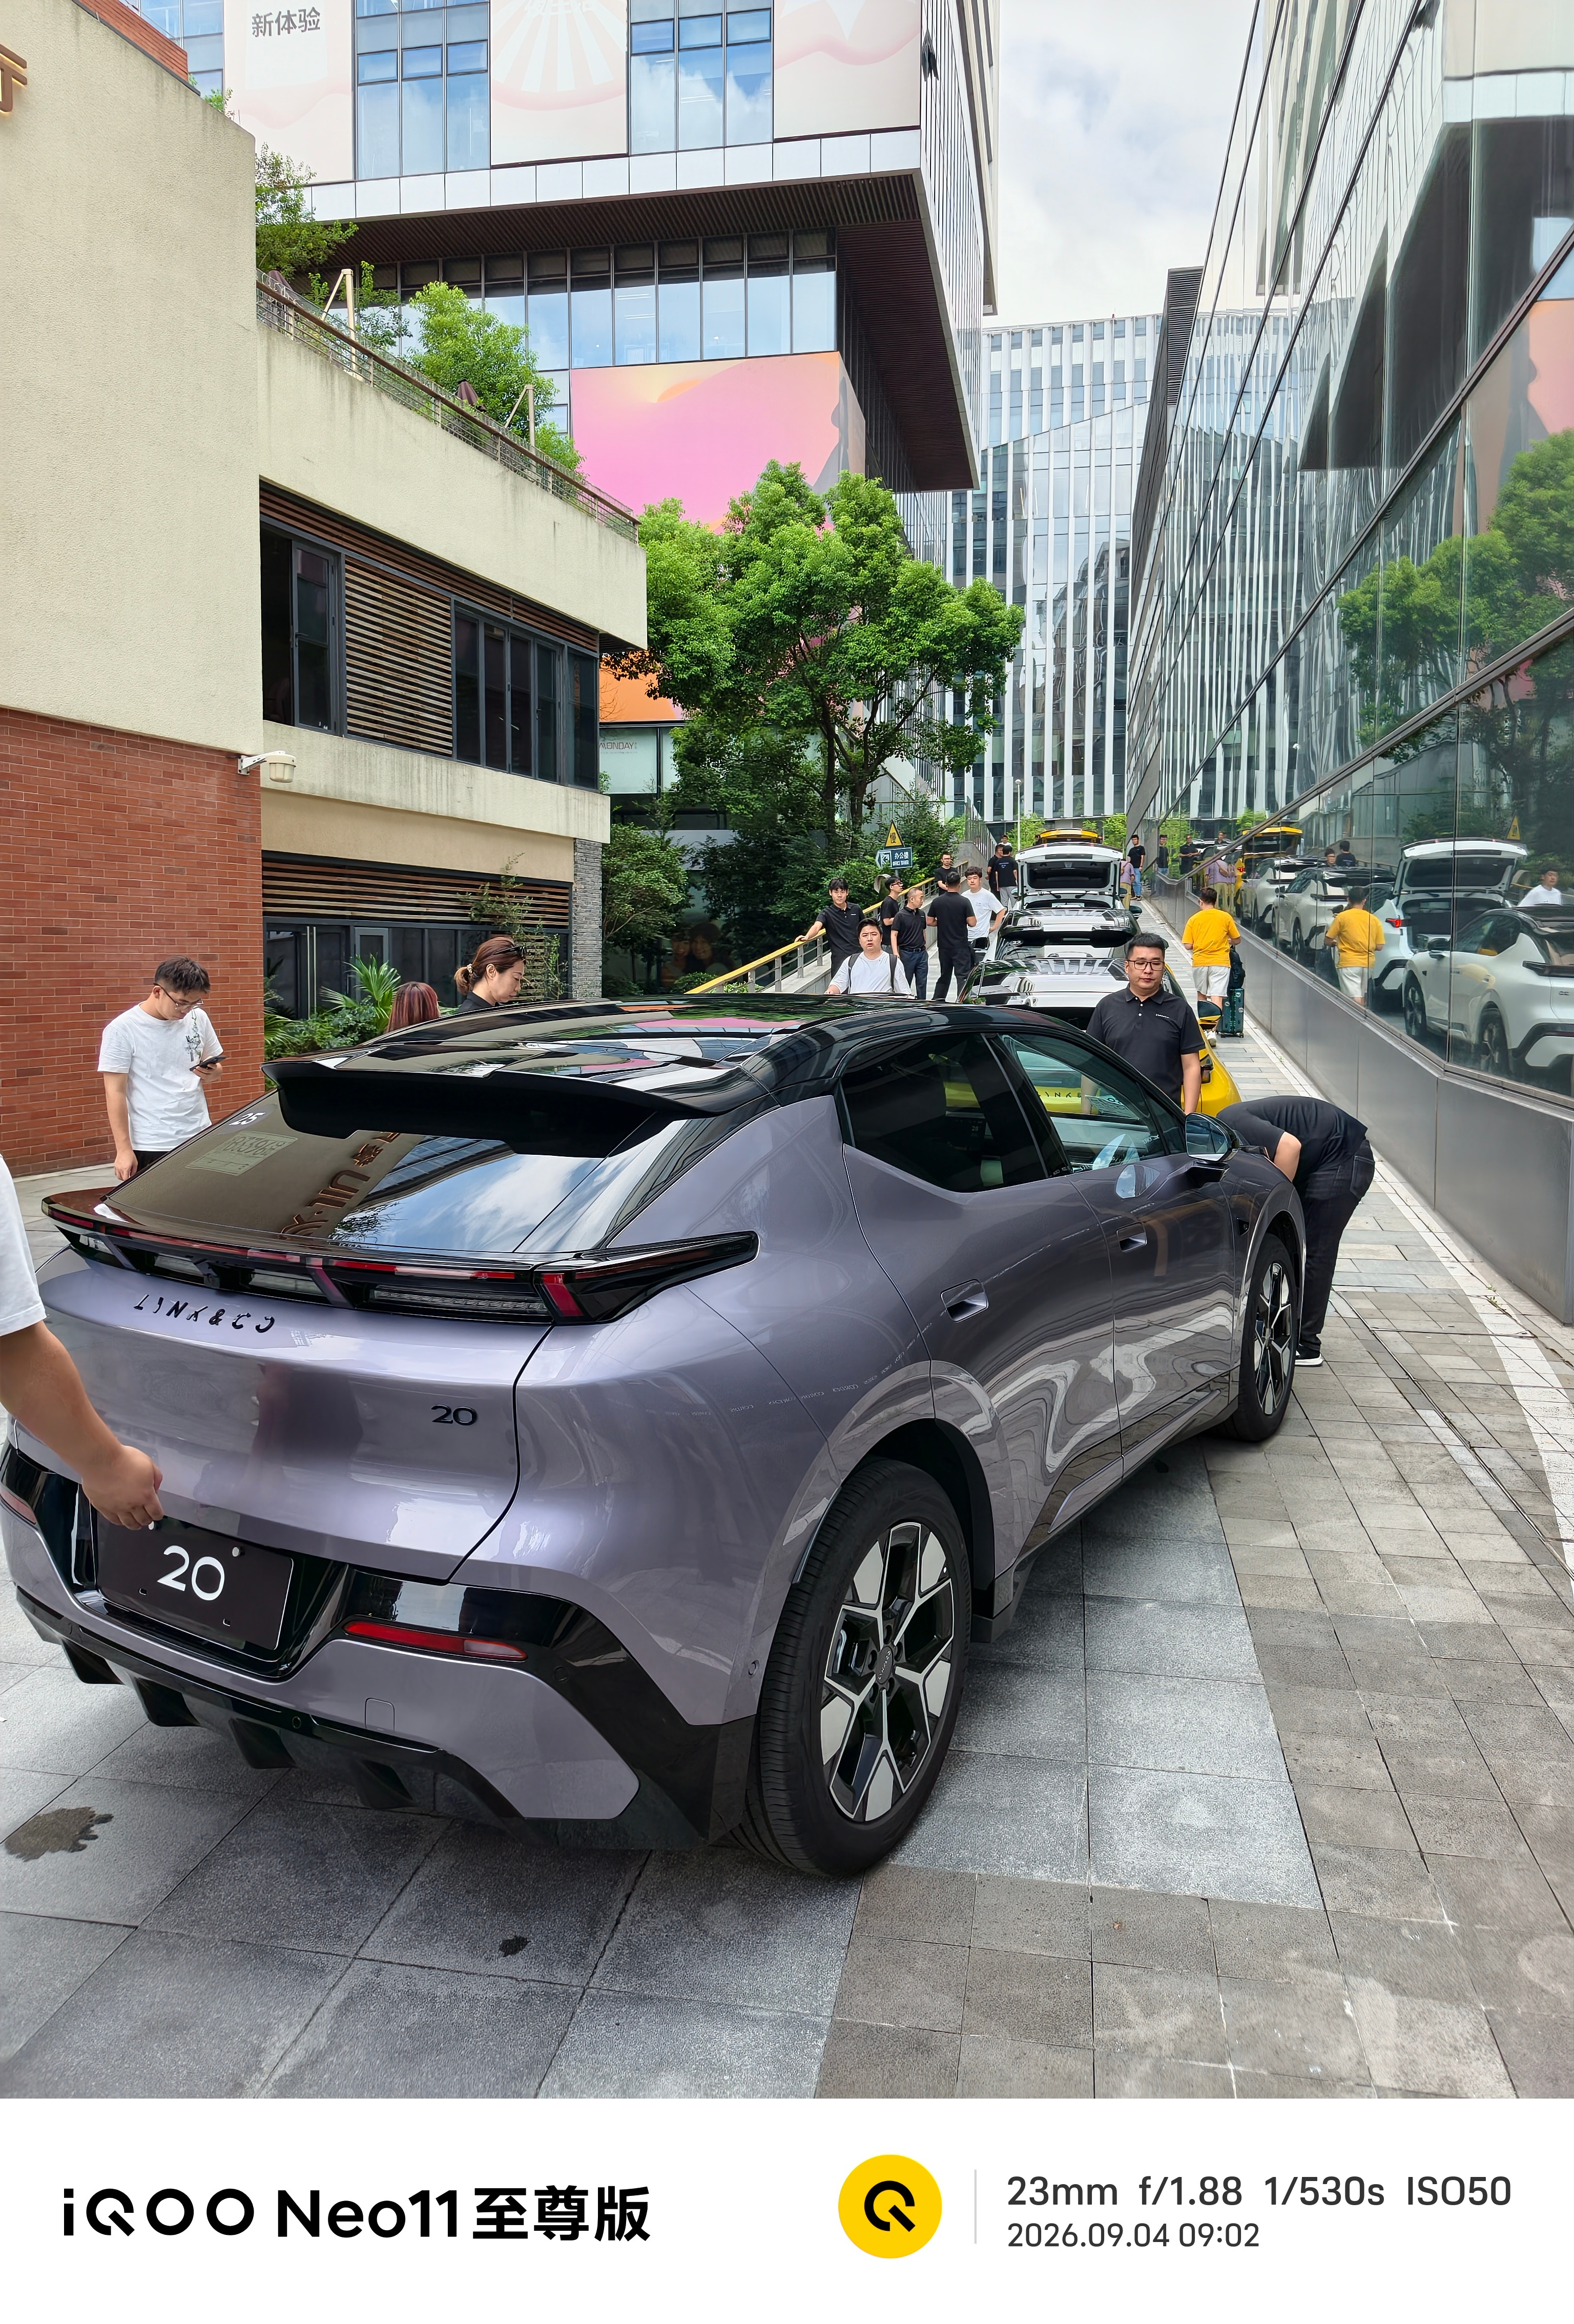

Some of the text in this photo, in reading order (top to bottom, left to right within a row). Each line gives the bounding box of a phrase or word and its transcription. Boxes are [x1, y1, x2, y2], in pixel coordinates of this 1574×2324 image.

[252, 7, 321, 37] 新体验
[229, 1112, 265, 1126] 25
[431, 1404, 478, 1426] 20
[157, 1545, 225, 1601] 20
